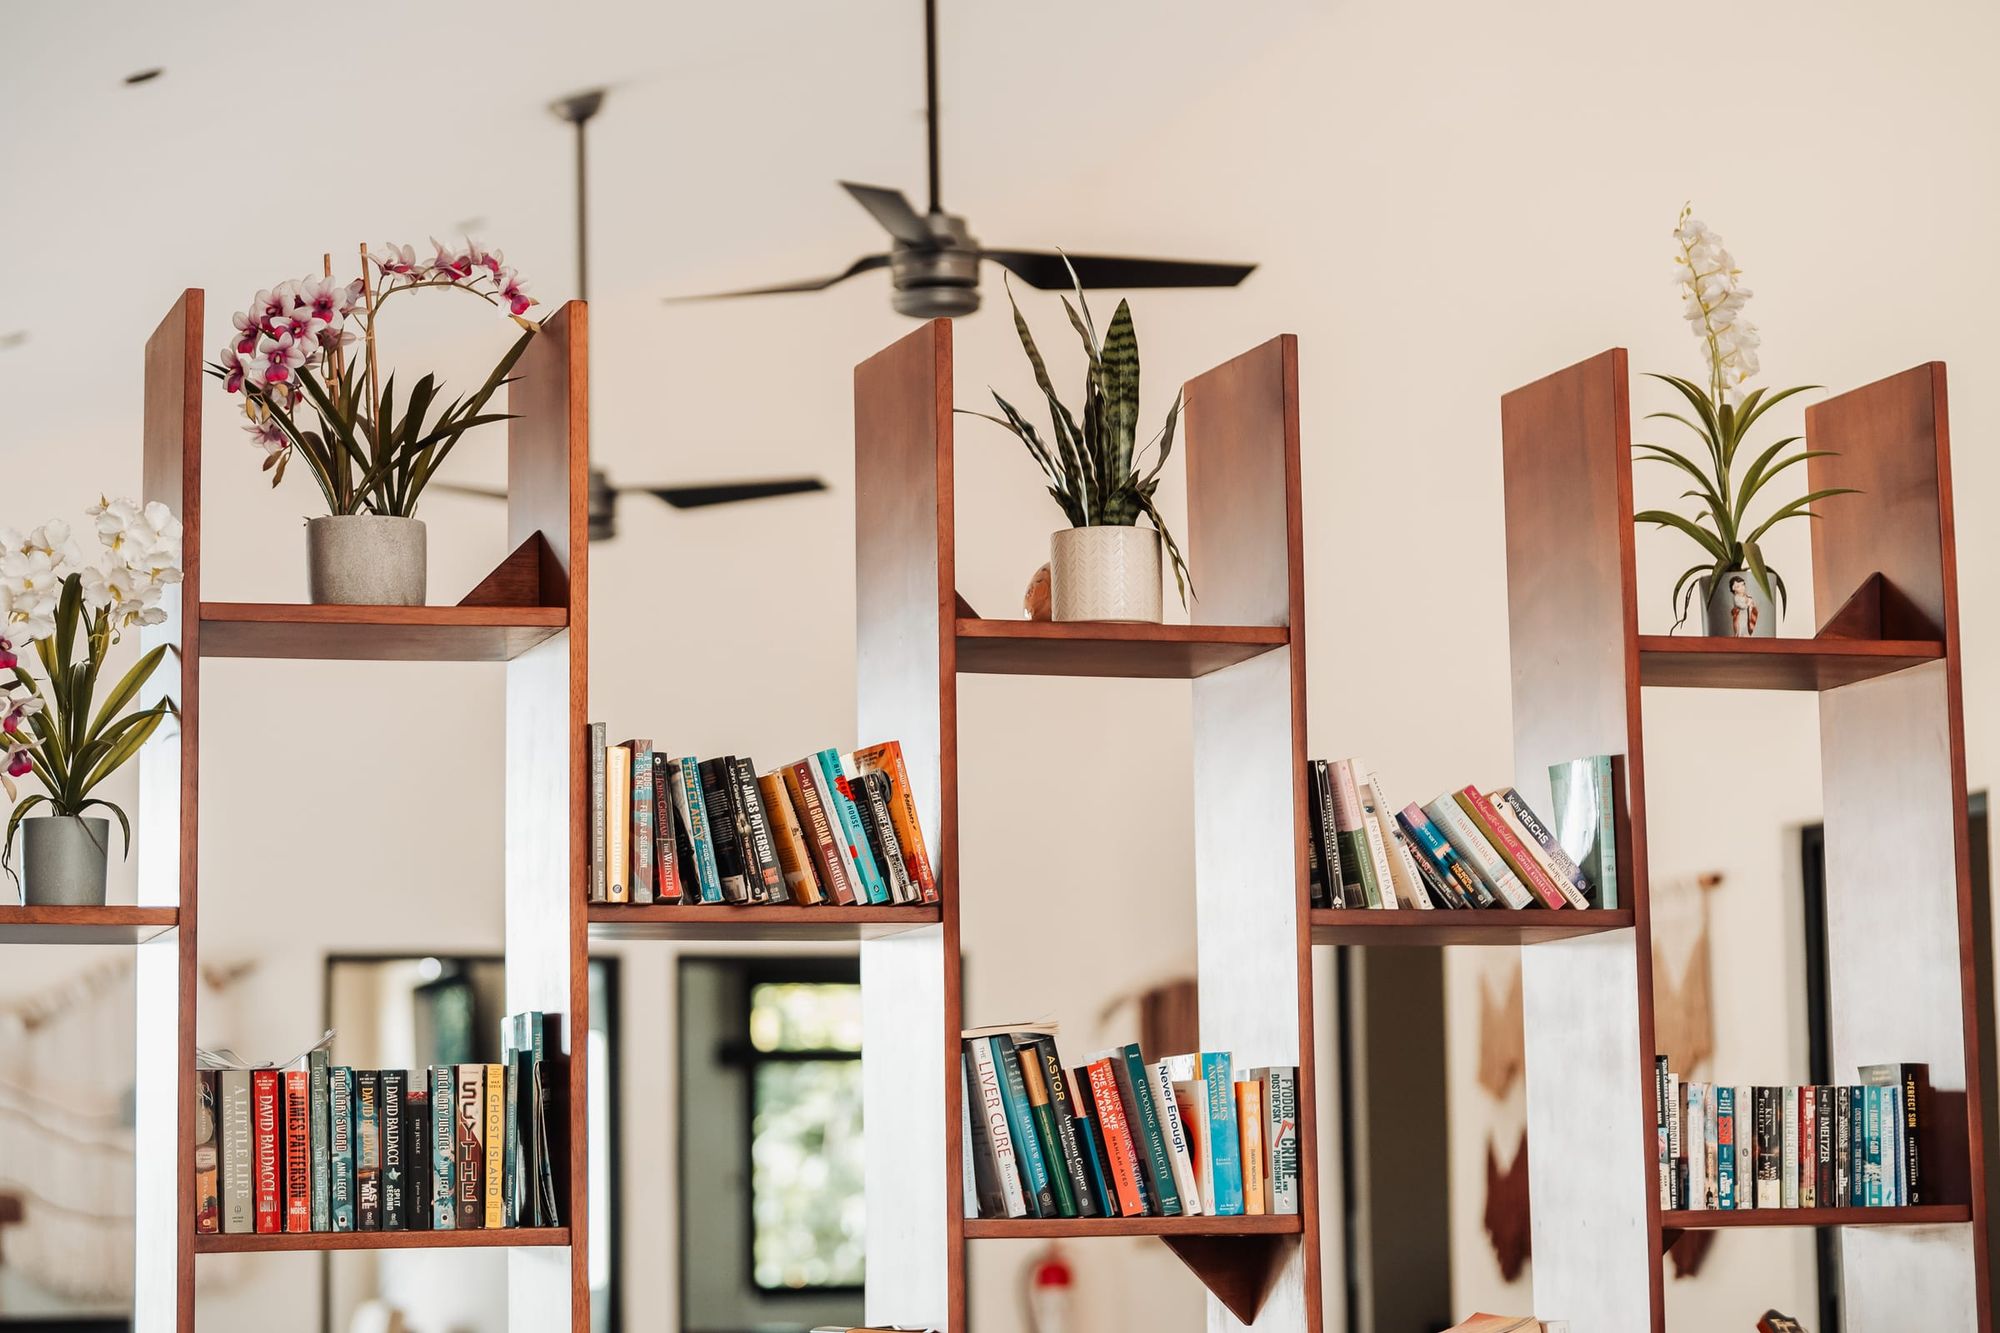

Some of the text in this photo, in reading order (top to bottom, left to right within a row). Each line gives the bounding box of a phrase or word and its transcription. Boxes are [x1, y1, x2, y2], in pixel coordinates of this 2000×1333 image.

[635, 752, 644, 794] OF SILENCE
[643, 763, 652, 791] PLEDGE
[727, 764, 738, 784] John
[682, 761, 705, 845] TOM CLANCY
[732, 782, 744, 814] Grisham
[742, 784, 759, 812] JAMES
[802, 783, 819, 809] JOHN
[847, 805, 860, 829] HOUSE
[639, 804, 647, 868] FLORA SOLOMON
[749, 810, 773, 863] PATTERSON
[810, 807, 833, 846] GRISHAM
[873, 798, 898, 856] SIDNEY SHELDON
[1419, 822, 1438, 847] Grisham
[1507, 794, 1522, 814] Kathy
[1518, 809, 1549, 845] REICHS
[662, 851, 676, 892] WHISTLER
[702, 844, 710, 862] CODE
[827, 856, 847, 893] RACKETEER
[1371, 833, 1386, 865] BUSCA
[1382, 877, 1393, 896] PAZ
[1516, 851, 1532, 872] SOPHIE
[1530, 870, 1552, 897] KINSELLA
[1543, 861, 1564, 882] Sleep
[534, 1032, 542, 1049] THE
[233, 1084, 247, 1096] A
[313, 1064, 324, 1109] Tom Lake
[1046, 1055, 1065, 1102] ASTOR
[1089, 1072, 1112, 1130] WON APART
[1097, 1067, 1119, 1130] THE WAR WE
[1111, 1089, 1123, 1113] ABUSE
[1207, 1063, 1219, 1121] ANONYMOUS
[1216, 1063, 1229, 1121] ALCOHOLICS
[1271, 1073, 1282, 1125] DOSTOEVSKY
[1280, 1078, 1294, 1119] FYODOR
[258, 1094, 274, 1135] DAVID
[288, 1092, 305, 1131] JAMES
[334, 1069, 347, 1153] ANCILLARY SWORD
[361, 1086, 375, 1117] DAVID
[385, 1086, 398, 1118] DAVID
[437, 1067, 450, 1151] ANCILLARY JUSTICE
[489, 1094, 500, 1140] GHOST
[977, 1045, 1012, 1158] THE LIVER CURE
[1158, 1065, 1184, 1154] Never Enough
[1906, 1080, 1916, 1128] PERFECT SON
[223, 1094, 233, 1190] HANYA YANAGIHARA
[234, 1101, 248, 1160] LITTLE
[361, 1119, 375, 1169] BALDACCI
[386, 1118, 400, 1167] BALDACCI
[460, 1080, 477, 1202] SCYTHE
[1137, 1078, 1169, 1180] CHOOSING SIMPLICITY
[1668, 1098, 1678, 1154] JOHN GRISHAM
[1819, 1120, 1830, 1163] MELTZER
[1869, 1140, 1878, 1154] GOD
[259, 1135, 276, 1193] BALDACCI
[289, 1134, 308, 1199] PATTERSON
[438, 1160, 449, 1177] ANN
[488, 1145, 499, 1197] ISLAND
[1021, 1114, 1040, 1161] MATTHEW
[1034, 1161, 1047, 1189] PERRY
[1063, 1113, 1088, 1191] Anderson Cooper
[1111, 1135, 1128, 1187] NAHLAH AYED
[1273, 1150, 1283, 1195] PUNISHMENT
[1281, 1137, 1297, 1180] CRIME
[236, 1162, 250, 1200] LIFE
[336, 1161, 347, 1202] ANN LECKIE
[360, 1183, 370, 1210] MILE
[367, 1180, 378, 1209] LAST
[386, 1184, 394, 1211] SECOND
[393, 1188, 401, 1208] SPLIT
[289, 1206, 308, 1216] NOISE
